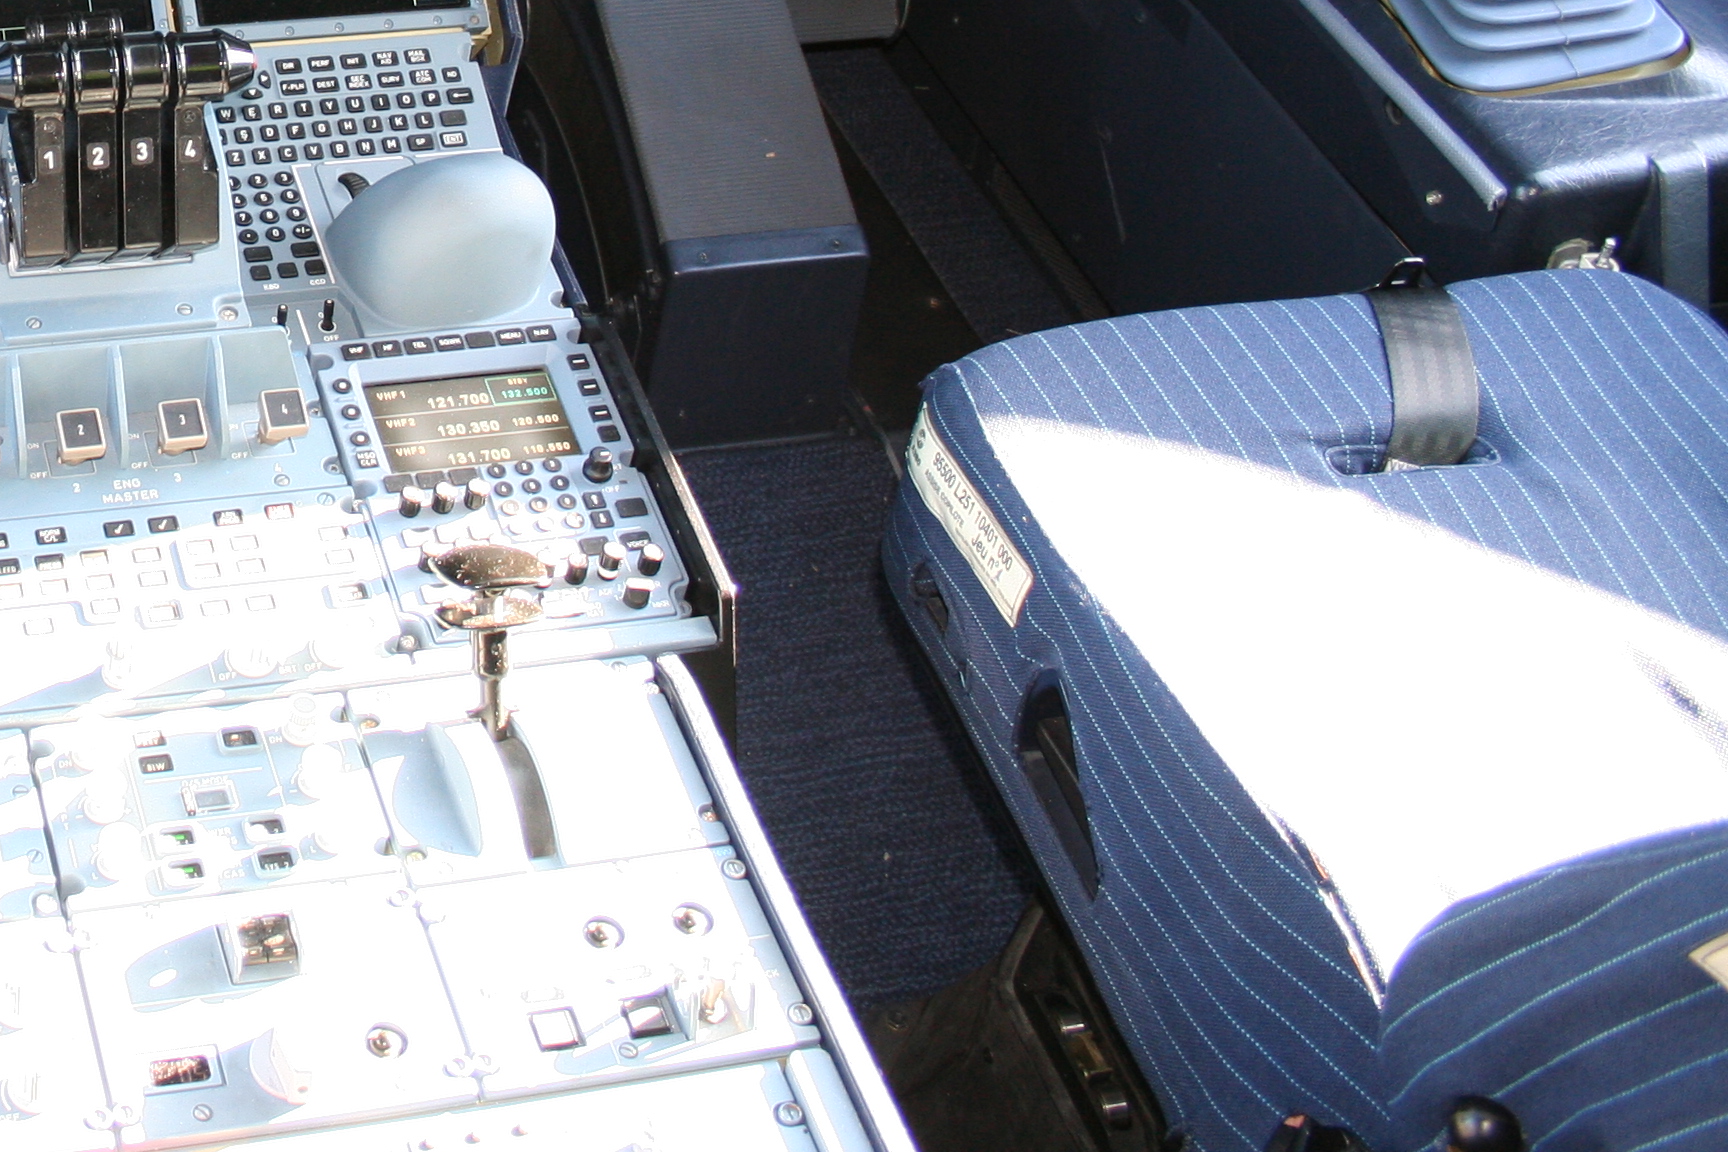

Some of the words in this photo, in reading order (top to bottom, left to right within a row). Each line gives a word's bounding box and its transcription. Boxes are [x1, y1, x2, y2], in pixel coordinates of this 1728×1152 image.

[92, 147, 104, 165] 2
[136, 142, 148, 160] 3
[184, 140, 195, 157] 4
[44, 152, 54, 168] 1
[426, 392, 490, 410] 121.700
[436, 419, 501, 437] 130.350
[113, 478, 141, 490] ENG
[102, 489, 159, 503] MASTER
